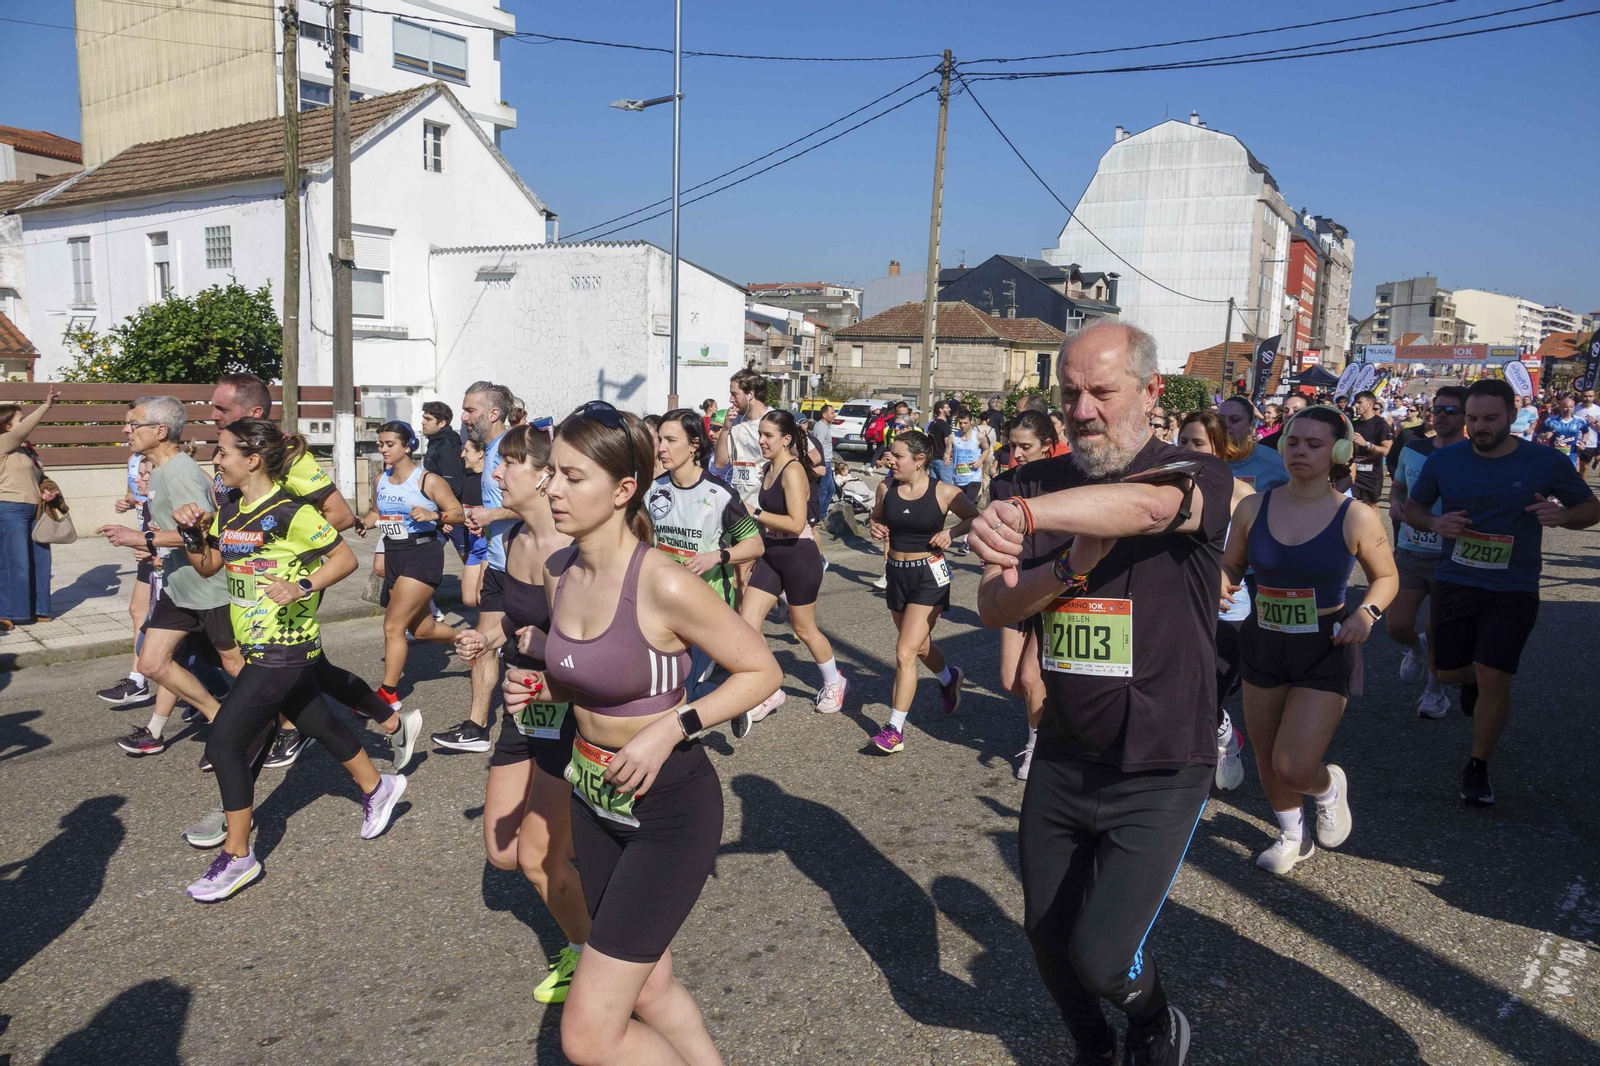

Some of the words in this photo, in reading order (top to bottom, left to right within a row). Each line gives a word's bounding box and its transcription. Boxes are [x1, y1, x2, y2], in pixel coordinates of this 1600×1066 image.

[738, 469, 750, 481] 783
[223, 530, 262, 542] FORMULA
[667, 537, 699, 552] CONDADO
[1461, 542, 1503, 563] 2297
[228, 577, 245, 599] 78
[1262, 601, 1307, 625] 2076
[1053, 624, 1111, 660] 2103
[586, 761, 600, 773] IRIA
